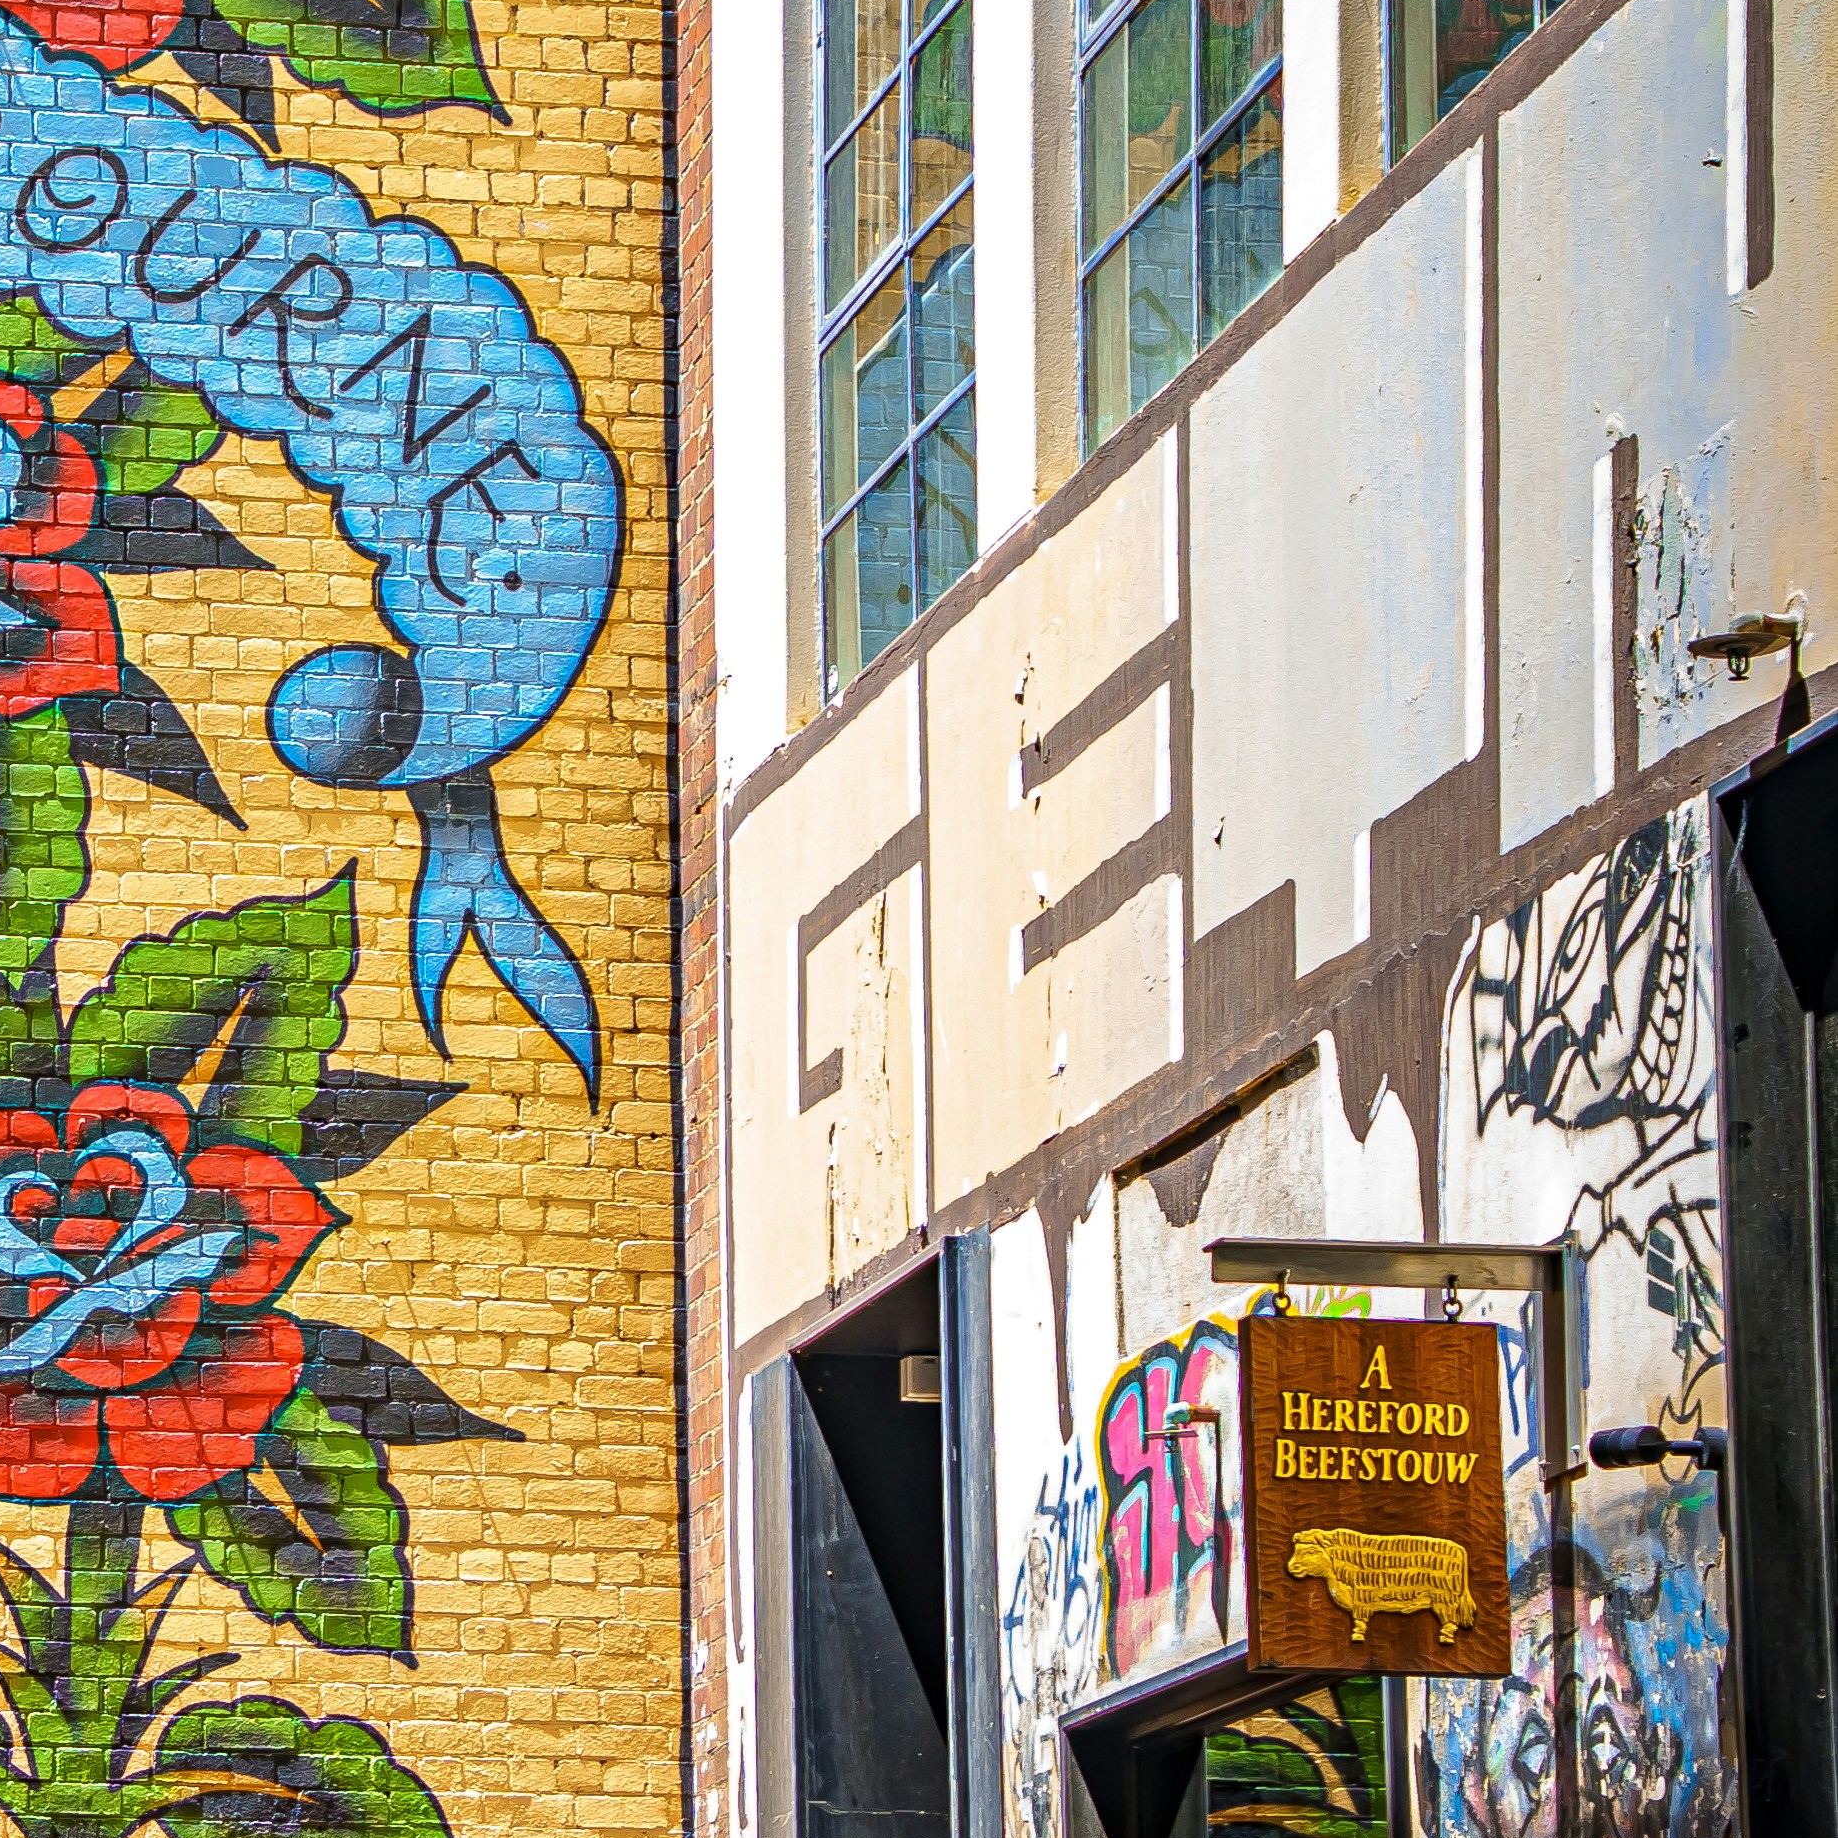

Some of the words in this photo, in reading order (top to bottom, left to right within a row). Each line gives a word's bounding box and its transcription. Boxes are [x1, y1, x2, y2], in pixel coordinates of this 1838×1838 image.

[1359, 1344, 1393, 1390] A
[1281, 1391, 1470, 1437] HEREFORD
[1274, 1438, 1480, 1485] BEEFSTOUW
